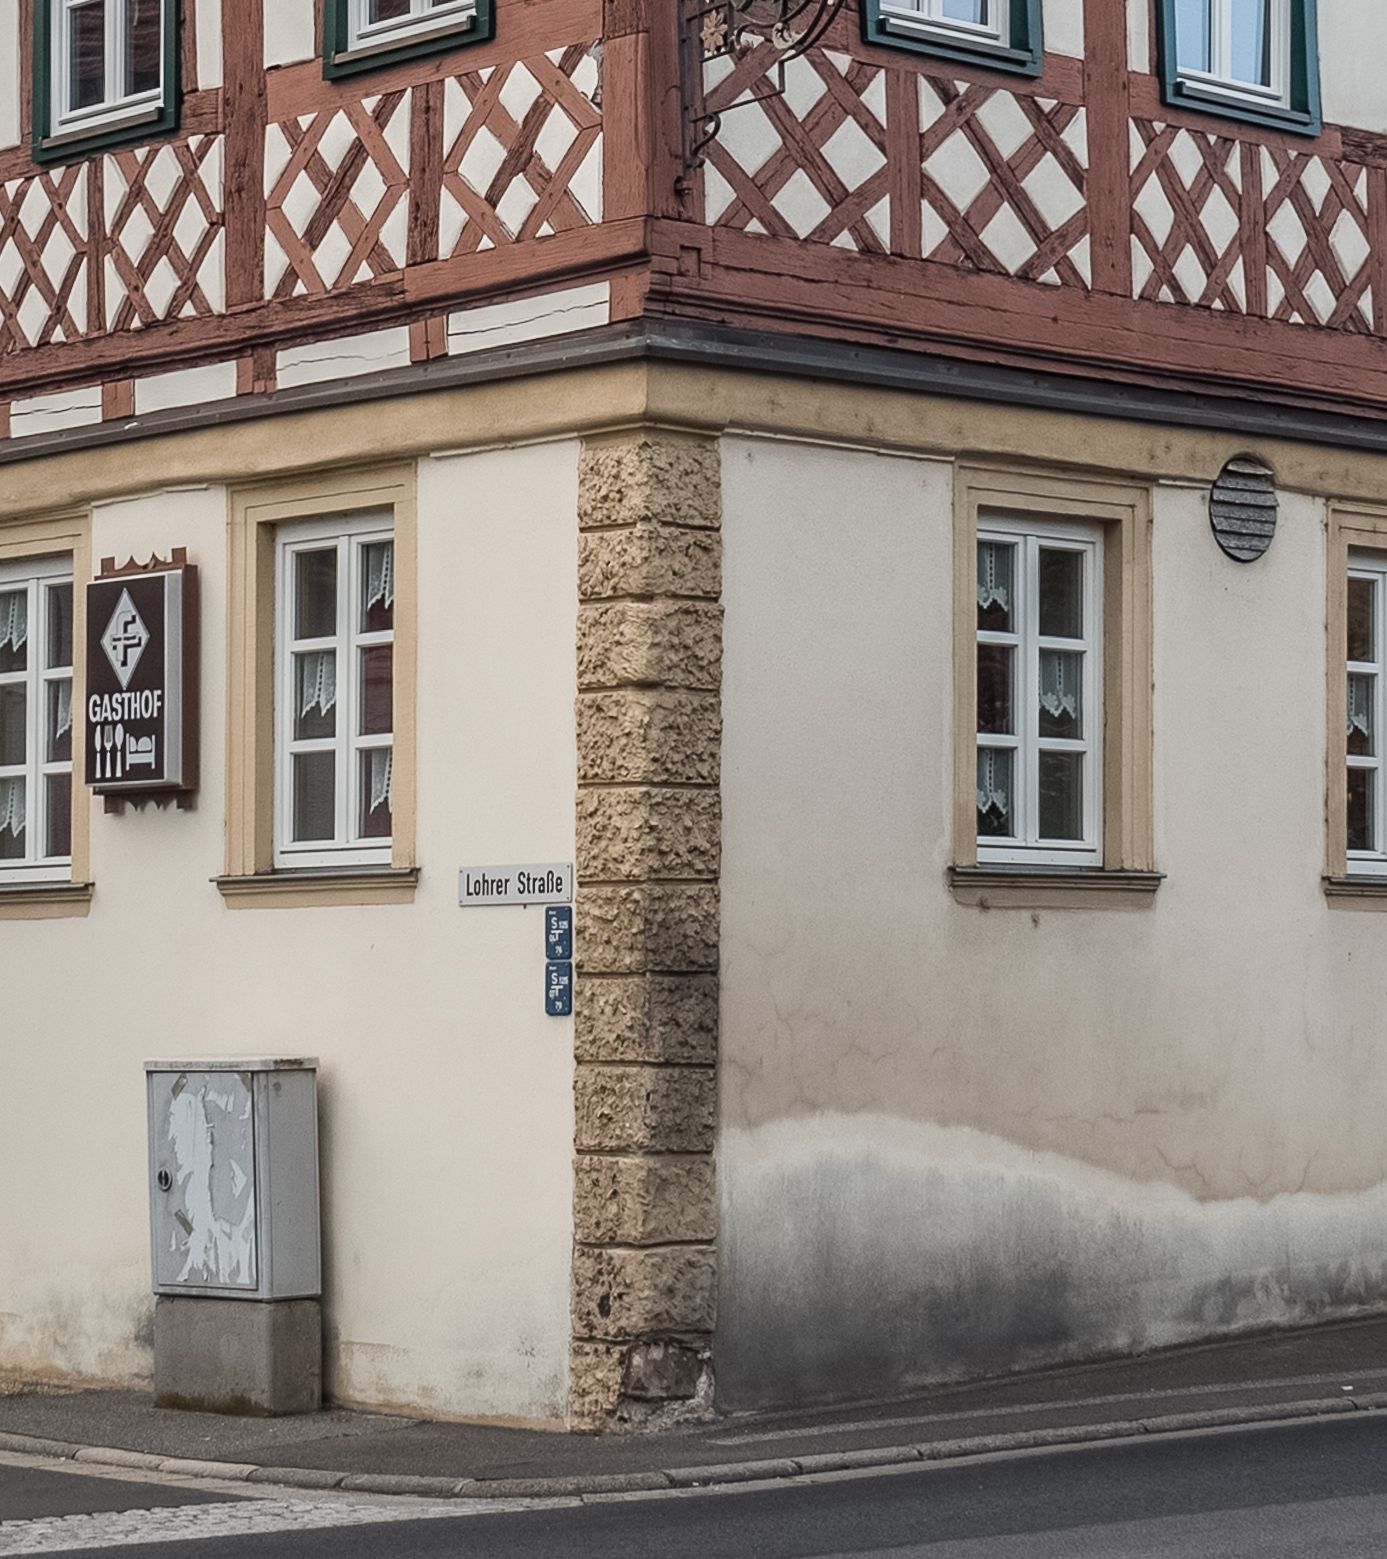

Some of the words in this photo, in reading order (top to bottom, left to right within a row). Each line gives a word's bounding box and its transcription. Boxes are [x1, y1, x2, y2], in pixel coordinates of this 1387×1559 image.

[88, 689, 162, 723] GASTHOF
[466, 872, 511, 897] Lohrer
[517, 870, 563, 895] Straße
